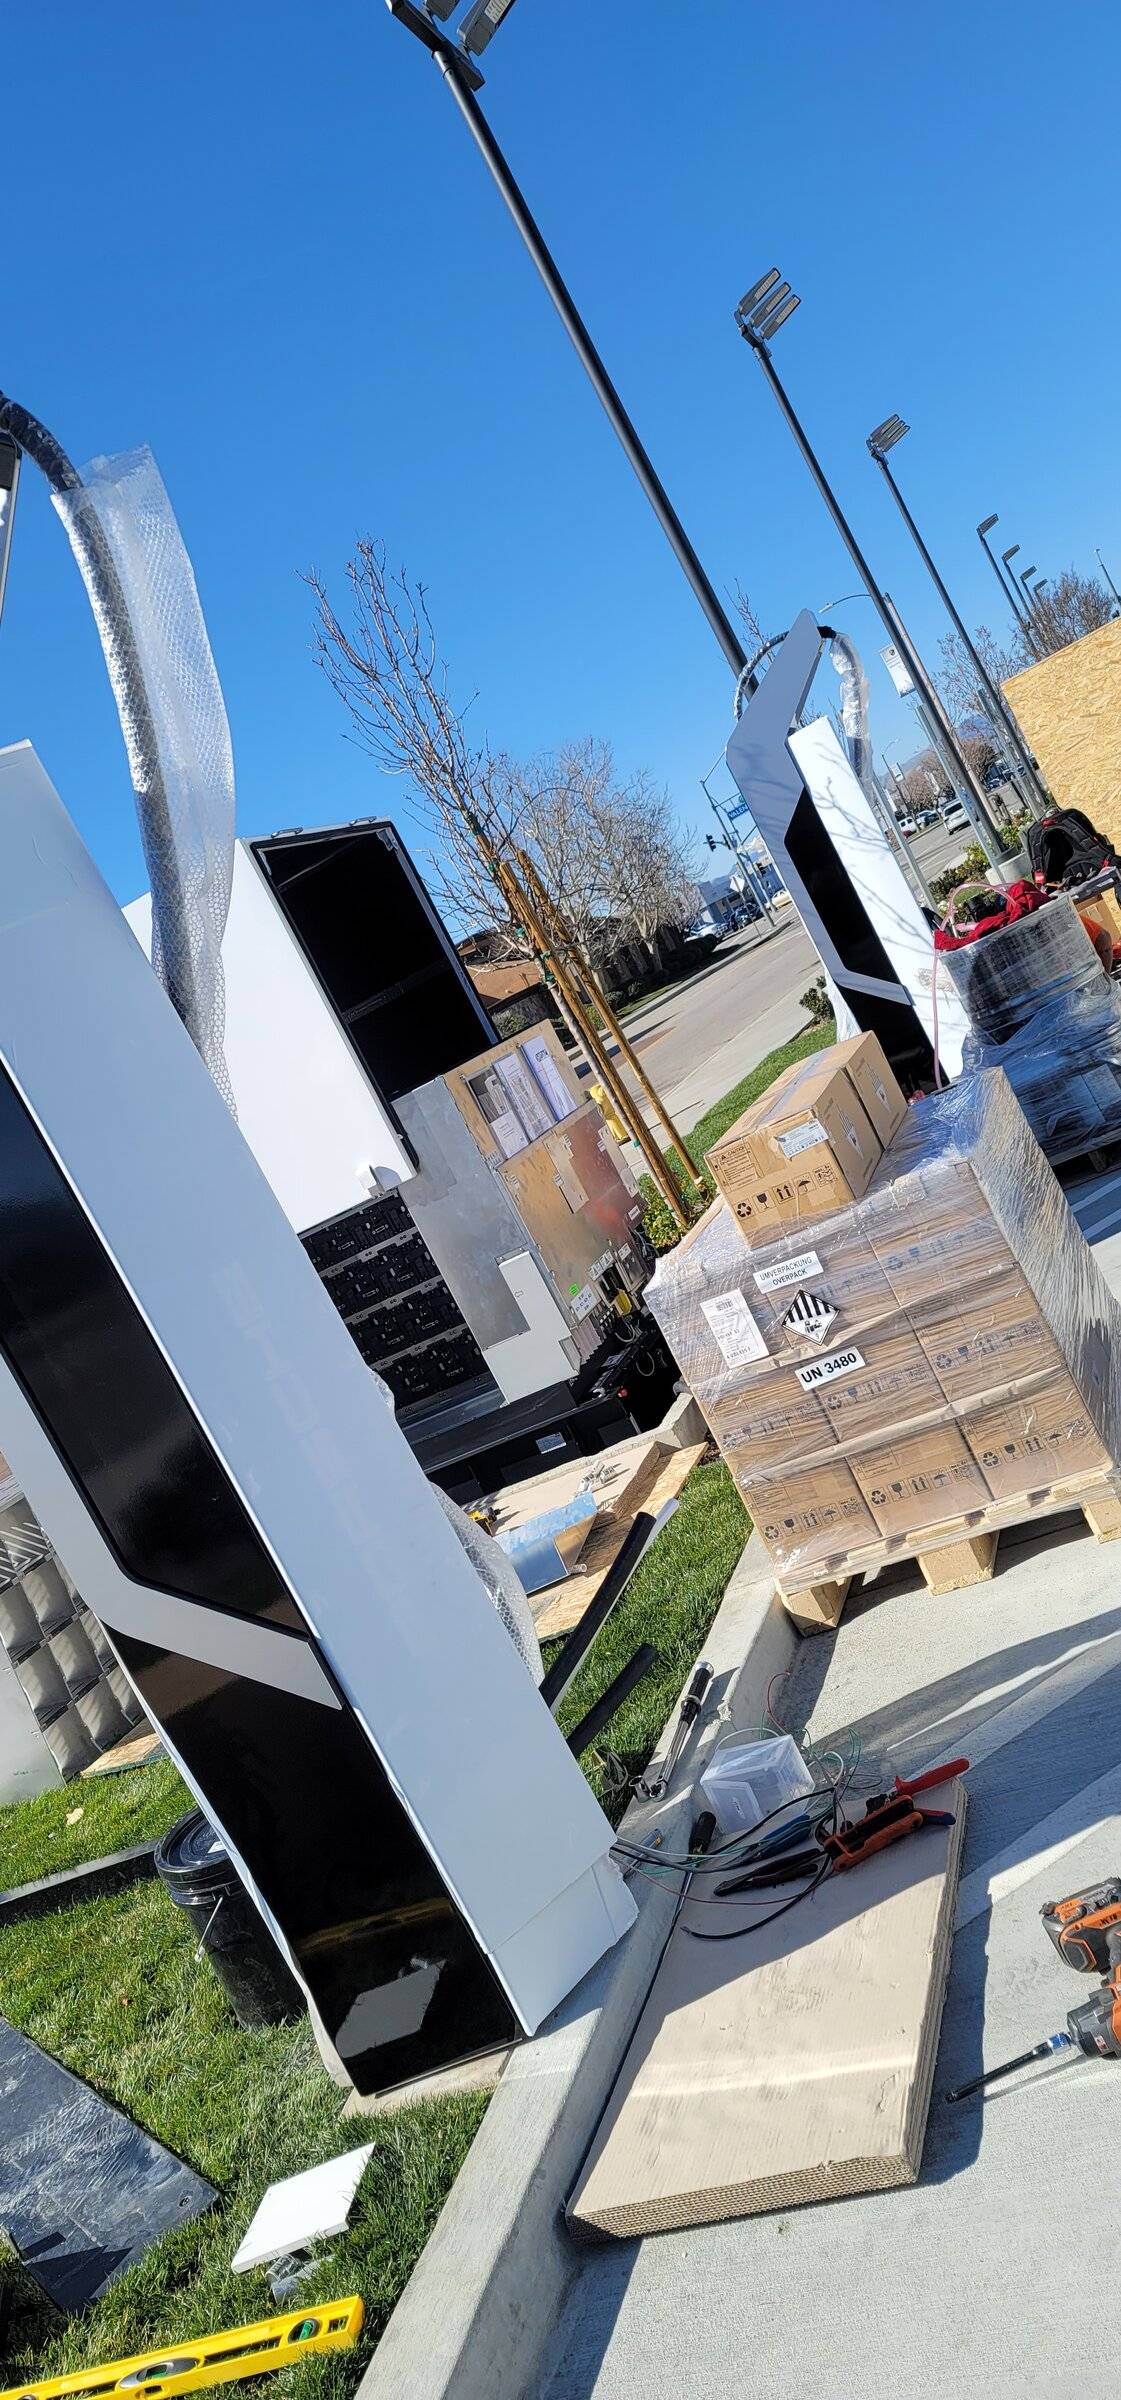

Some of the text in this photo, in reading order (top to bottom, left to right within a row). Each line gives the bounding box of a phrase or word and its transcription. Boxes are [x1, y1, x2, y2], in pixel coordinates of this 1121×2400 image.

[759, 1256, 812, 1281] UMVERPACKUNG
[772, 1268, 808, 1286] OVERPACK
[801, 1352, 857, 1383] UN 3480
